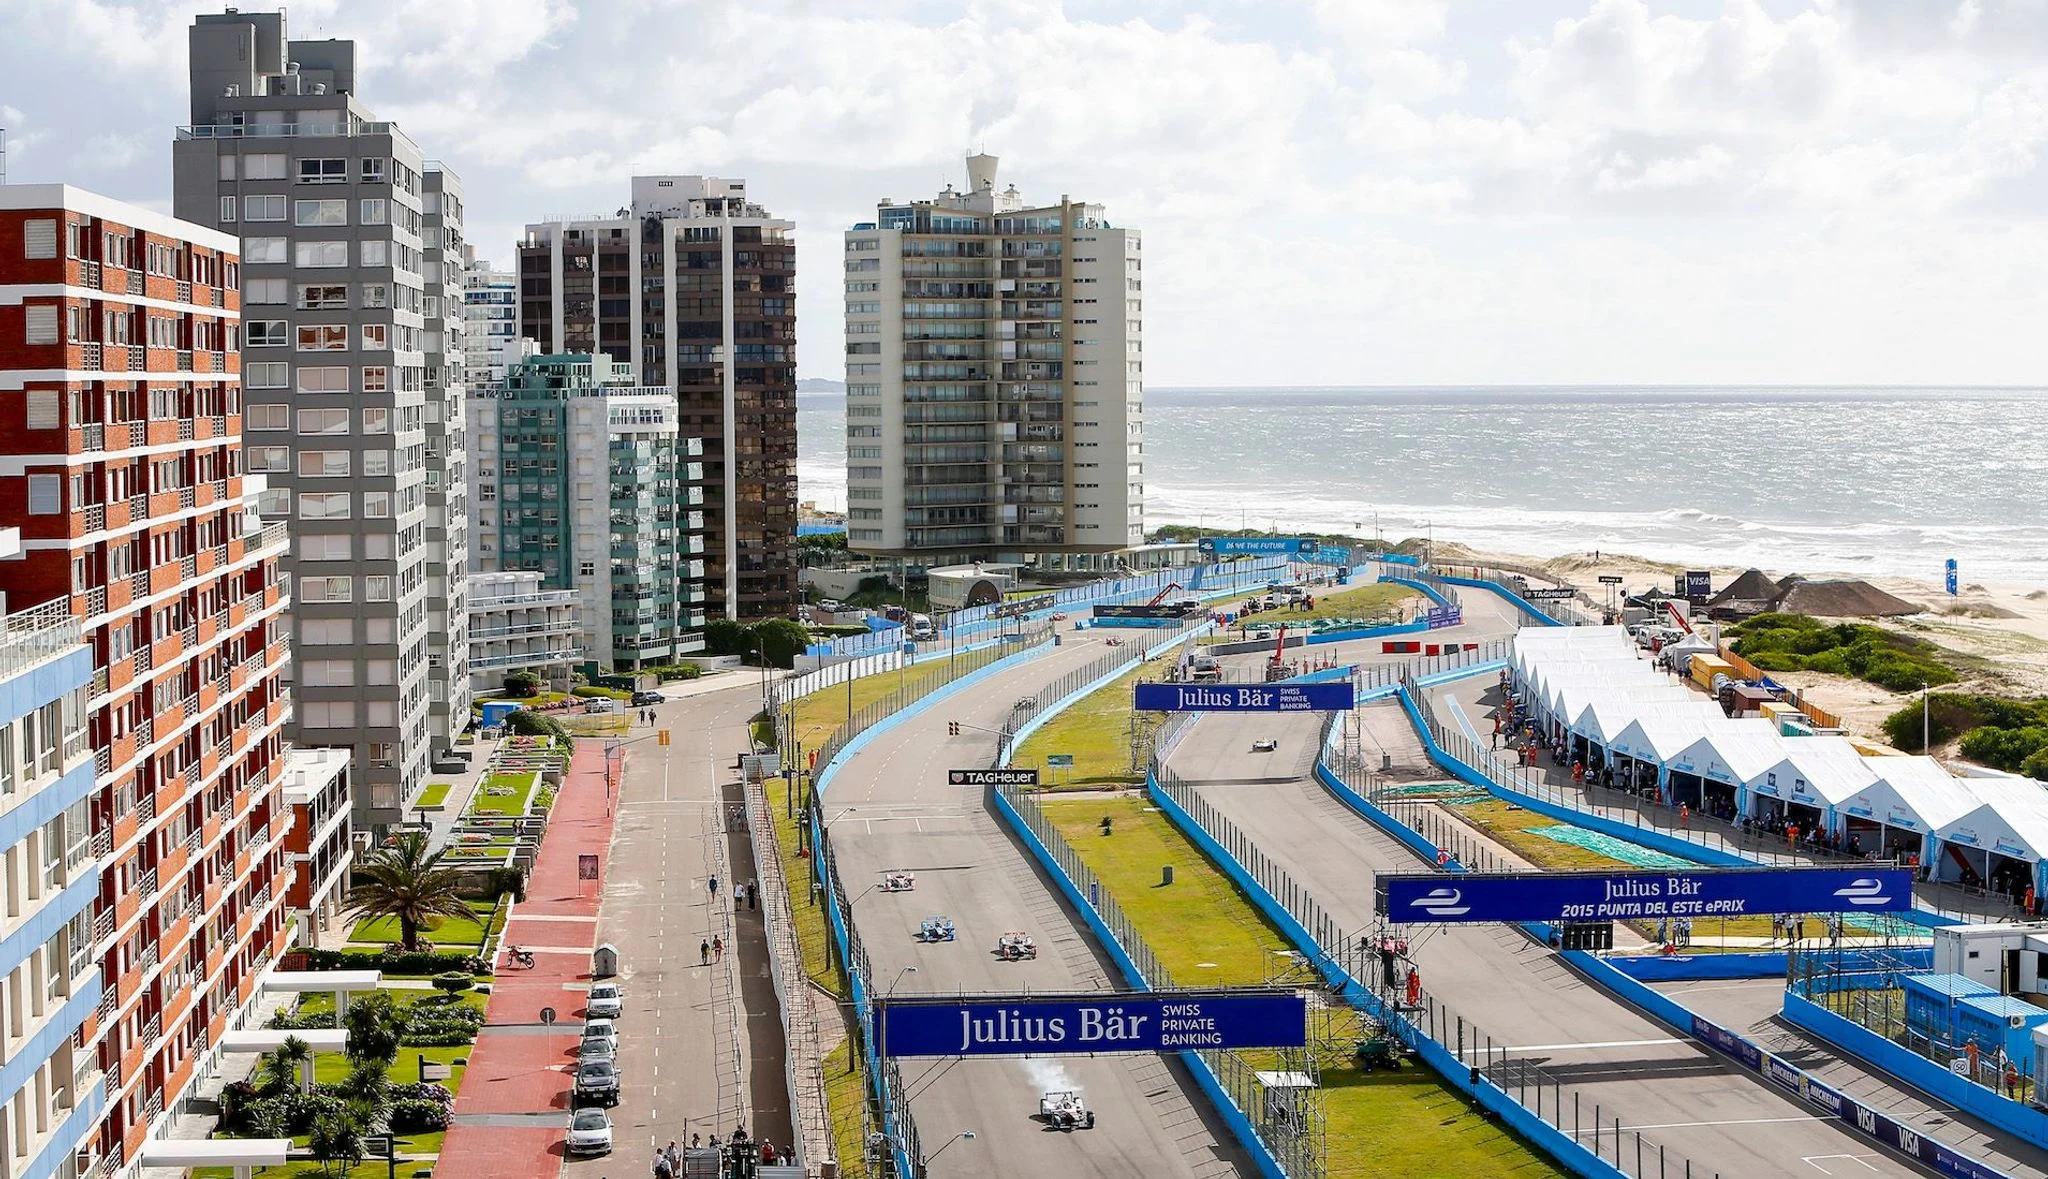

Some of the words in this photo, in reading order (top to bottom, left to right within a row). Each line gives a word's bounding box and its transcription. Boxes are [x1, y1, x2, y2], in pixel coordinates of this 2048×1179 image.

[1688, 577, 1709, 585] VISA
[1178, 688, 1232, 709] Julius
[1238, 689, 1273, 706] Bär
[1280, 702, 1311, 710] BANKING
[1605, 878, 1660, 901] Julius
[1667, 877, 1702, 896] Bär
[1561, 904, 1595, 918] 2015
[1598, 902, 1641, 916] PUNTA
[1645, 902, 1668, 914] DEL
[1672, 901, 1703, 914] ESTE
[1705, 899, 1745, 912] ePRIX
[1161, 1004, 1201, 1016] SWISS
[960, 1009, 1066, 1051] Julius
[1078, 1007, 1148, 1041] Bär
[1161, 1018, 1215, 1031] PRIVATE
[1161, 1032, 1222, 1046] BANKING
[1772, 1062, 1799, 1087] MICHELIN
[1810, 1084, 1841, 1109] MICHELIN
[1856, 1105, 1876, 1135] VISA
[1897, 1126, 1920, 1158] VISA
